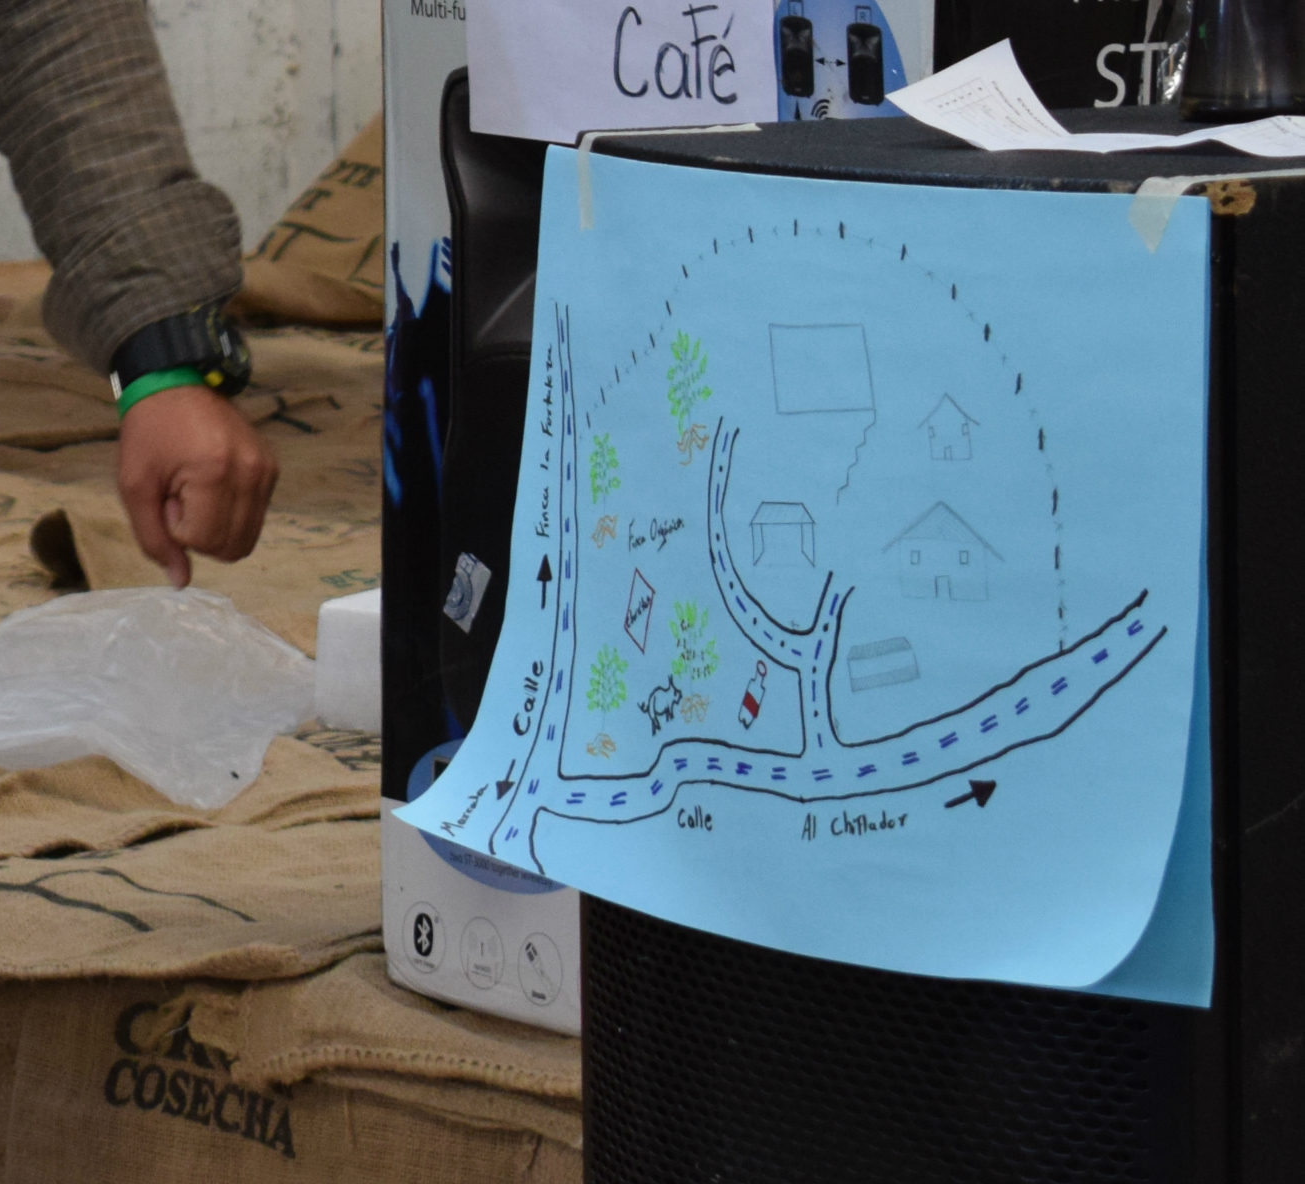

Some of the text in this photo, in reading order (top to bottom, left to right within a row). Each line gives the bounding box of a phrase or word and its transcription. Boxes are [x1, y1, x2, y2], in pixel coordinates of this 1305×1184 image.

[513, 660, 544, 736] Calle
[677, 804, 713, 831] Calle
[103, 1058, 297, 1160] COSECHA
